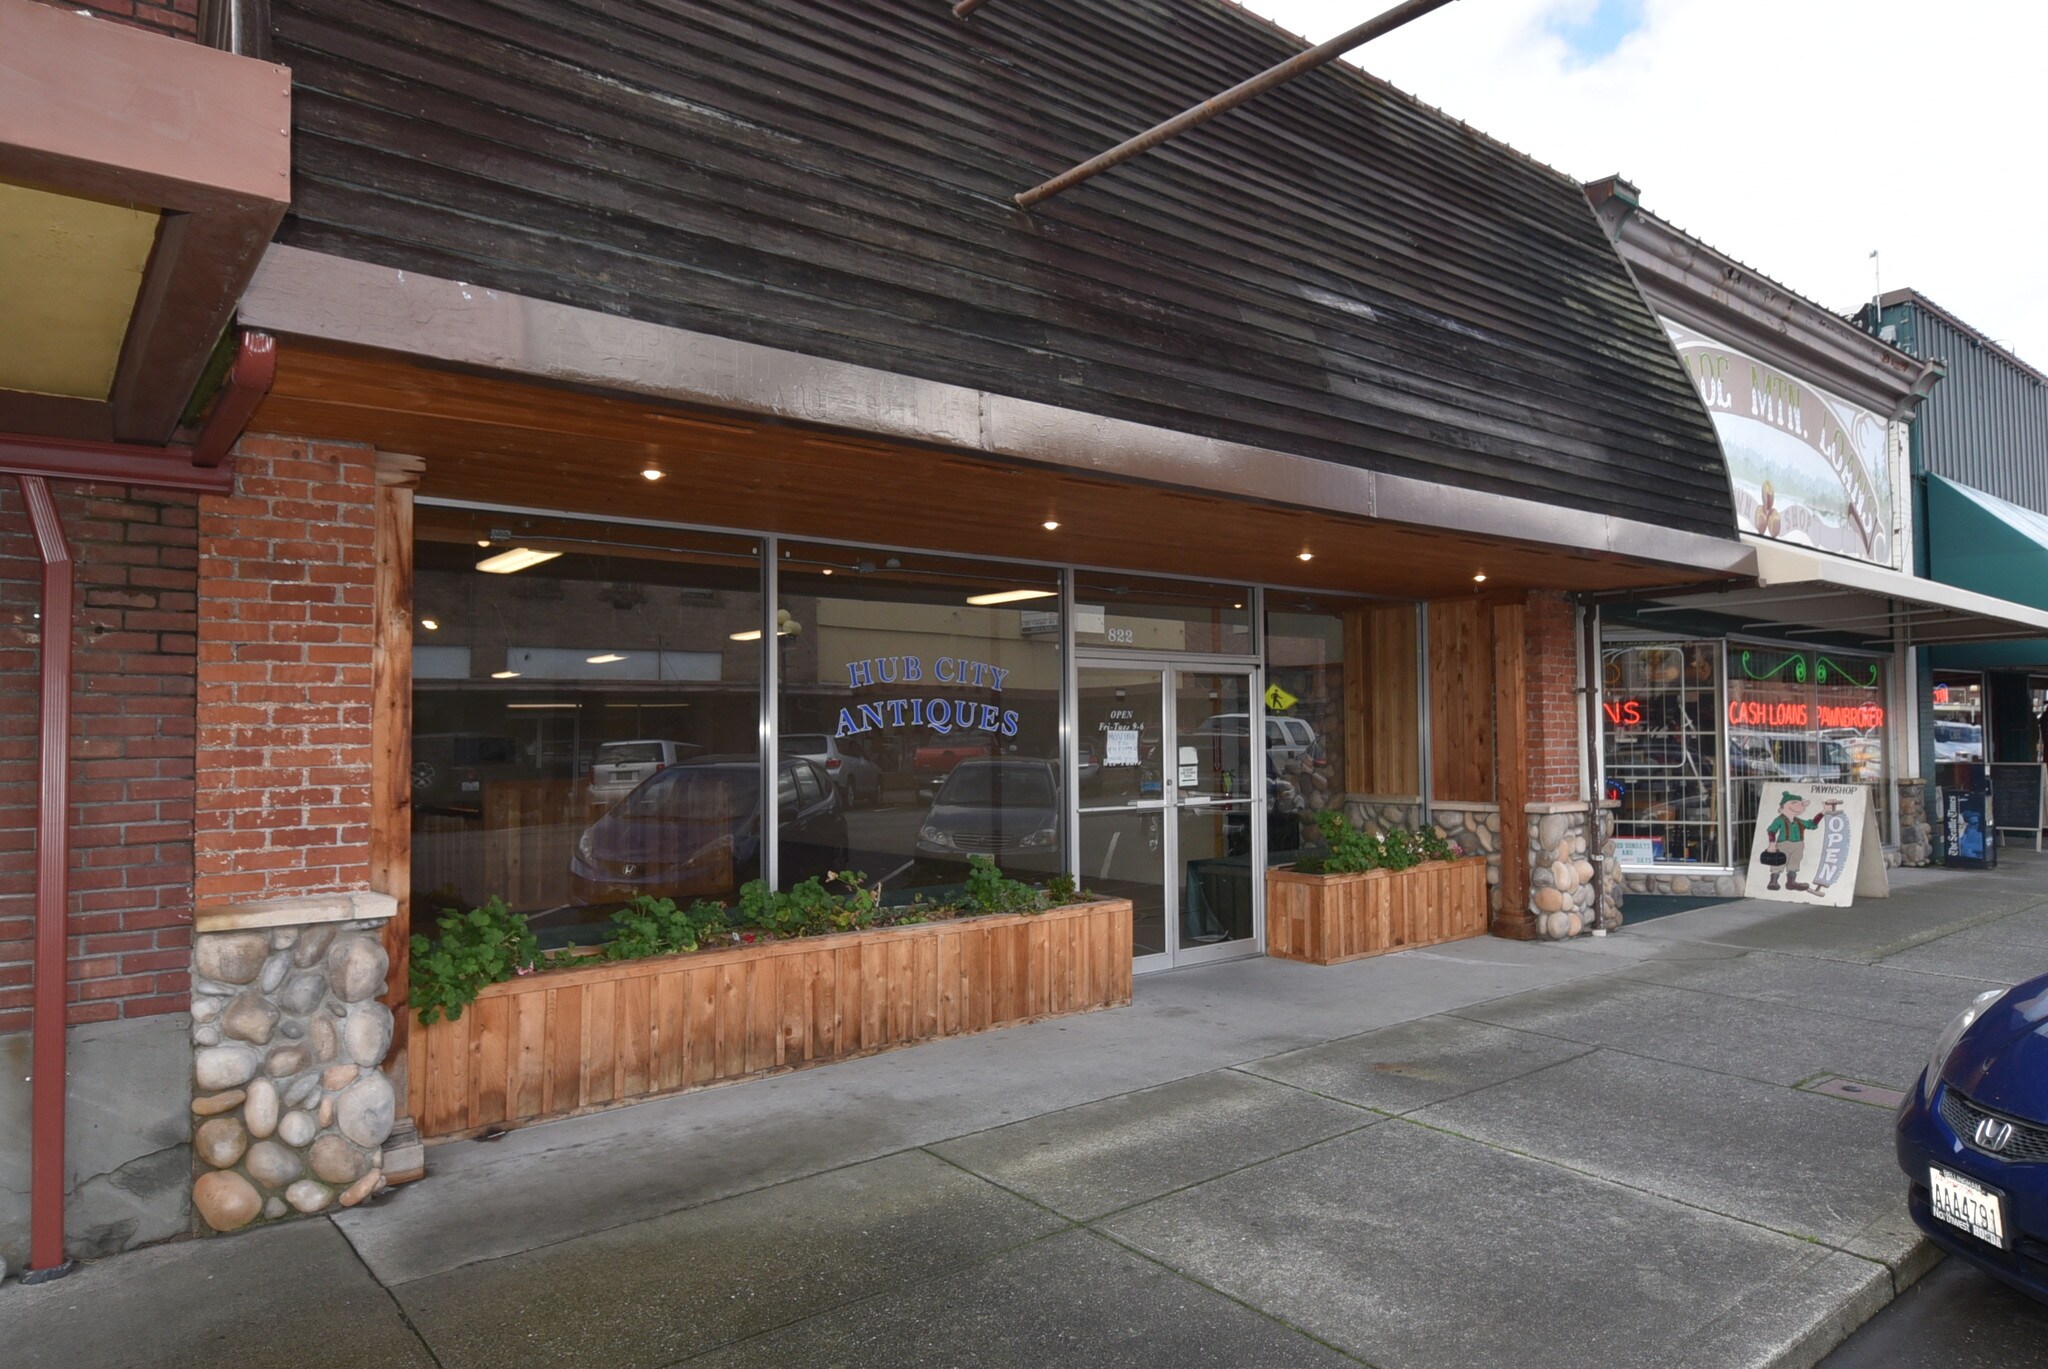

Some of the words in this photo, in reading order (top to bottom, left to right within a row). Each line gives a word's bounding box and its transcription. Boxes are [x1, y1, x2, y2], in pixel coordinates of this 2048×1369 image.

[1751, 366, 1808, 439] MTN.
[1819, 410, 1874, 534] LOANS
[1784, 506, 1812, 533] SHOP
[1108, 628, 1134, 644] 822
[846, 655, 923, 689] HUB
[934, 656, 1010, 692] CITY
[835, 698, 1019, 738] ANTIQUES
[1110, 710, 1134, 719] OPEN
[1132, 722, 1145, 731] 9-6
[1729, 701, 1766, 726] CASH
[1769, 703, 1807, 727] LOANS
[1817, 705, 1884, 728] PAWNBROKER
[1810, 785, 1858, 795] PAWNSHOP
[1947, 795, 1957, 817] Times
[1947, 817, 1958, 841] Seattle
[1818, 816, 1845, 881] OPEN
[1948, 842, 1959, 856] The
[1932, 1205, 1971, 1233] Northwest
[1935, 1183, 1997, 1235] AAA4791
